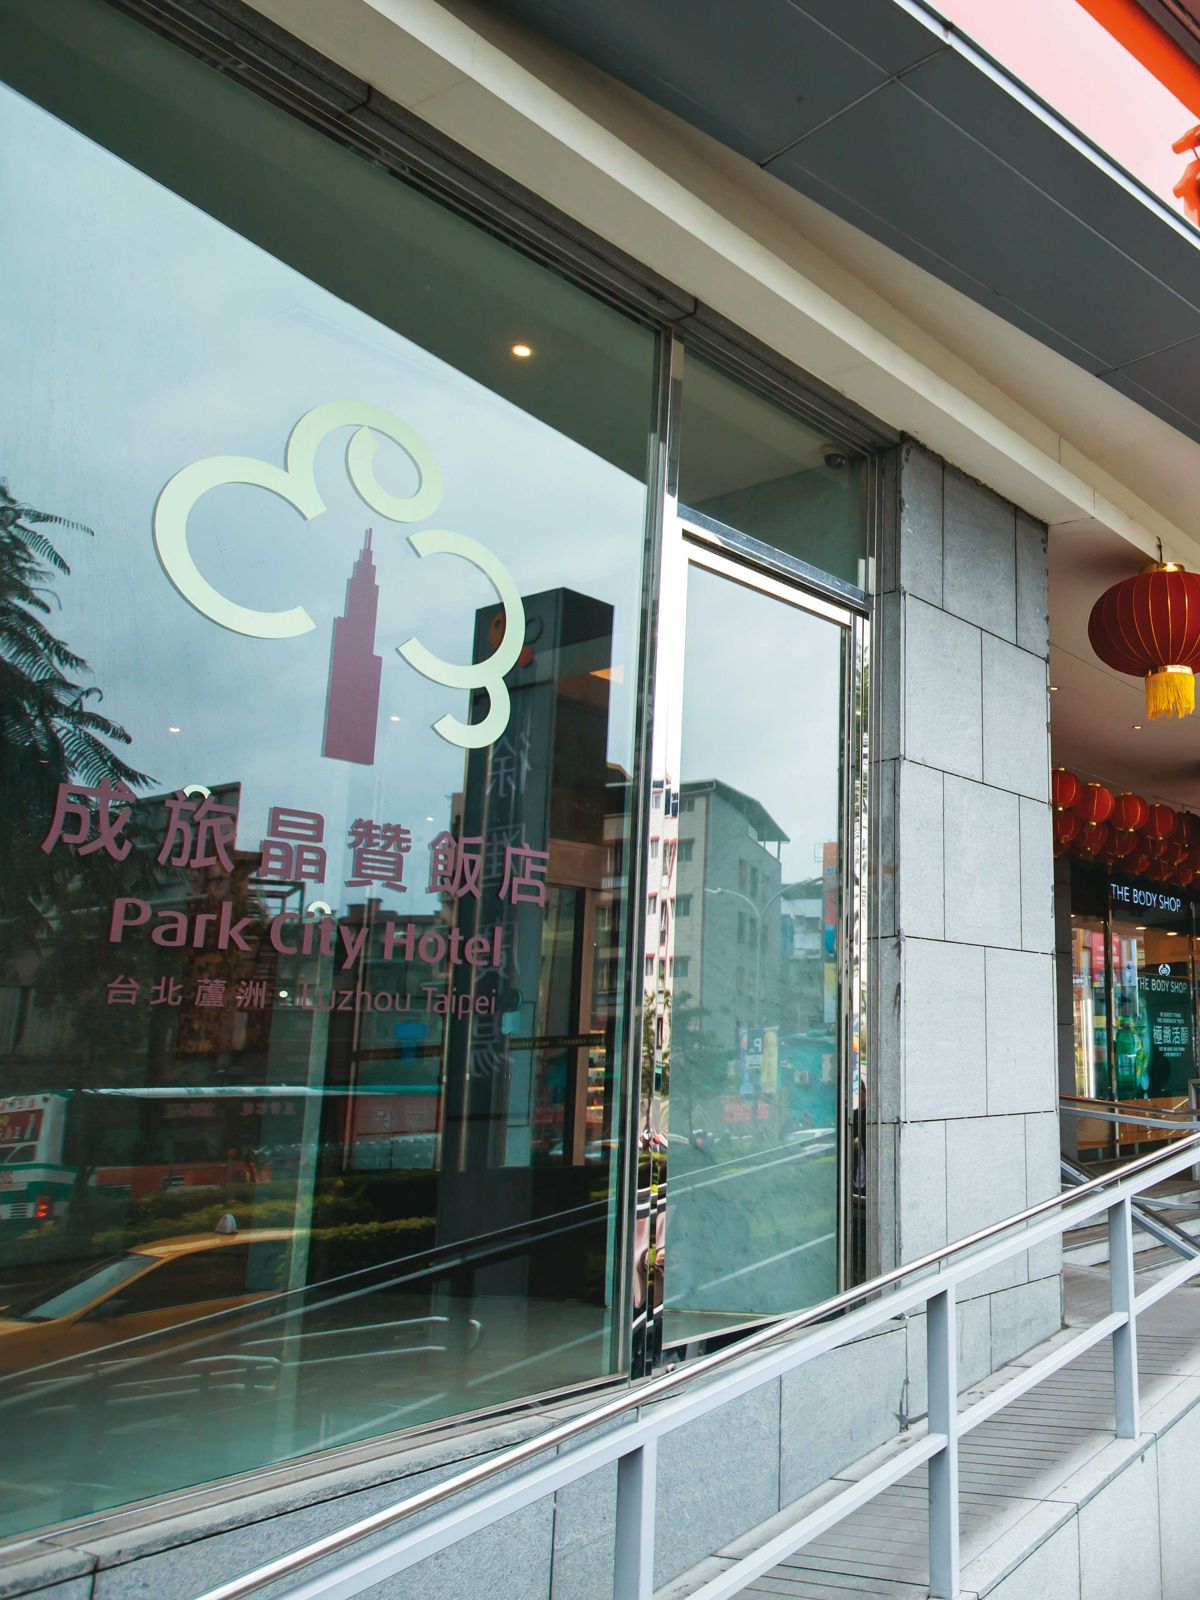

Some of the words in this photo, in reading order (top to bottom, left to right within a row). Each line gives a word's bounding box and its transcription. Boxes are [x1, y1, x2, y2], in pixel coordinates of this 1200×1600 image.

[42, 779, 550, 909] 成旅晶贊飯店
[1110, 883, 1130, 902] THE
[1132, 888, 1158, 908] BODY
[1158, 894, 1182, 913] SHOP
[109, 897, 253, 952] Park
[270, 910, 368, 970] City
[383, 921, 502, 968] Hotel
[106, 975, 267, 1009] 台北蘆洲
[299, 980, 411, 1013] Luzhou
[421, 986, 497, 1020] Taipei
[1151, 978, 1170, 992] BODY
[1170, 980, 1188, 994] SHOP
